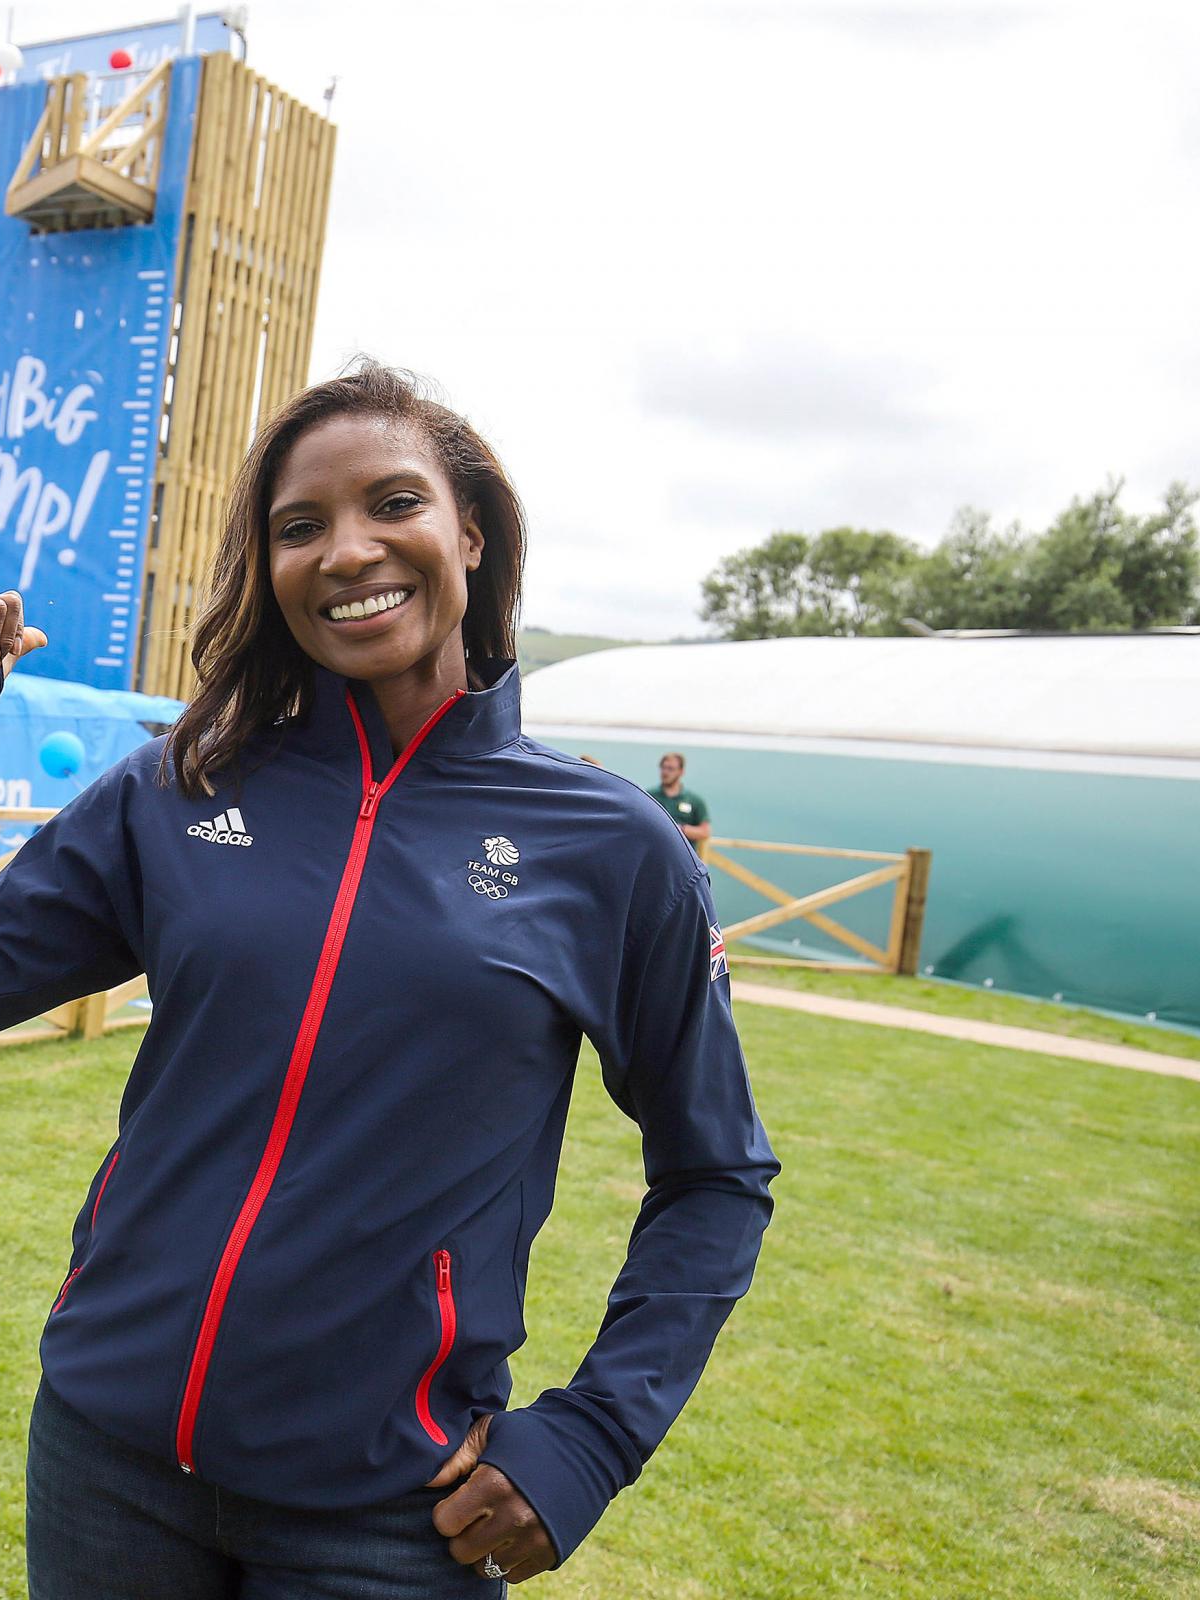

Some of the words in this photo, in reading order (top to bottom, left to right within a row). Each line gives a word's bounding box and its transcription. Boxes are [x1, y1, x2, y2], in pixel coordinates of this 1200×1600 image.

[186, 825, 254, 847] adidas
[467, 860, 500, 879] TEAM
[501, 872, 519, 886] GB
